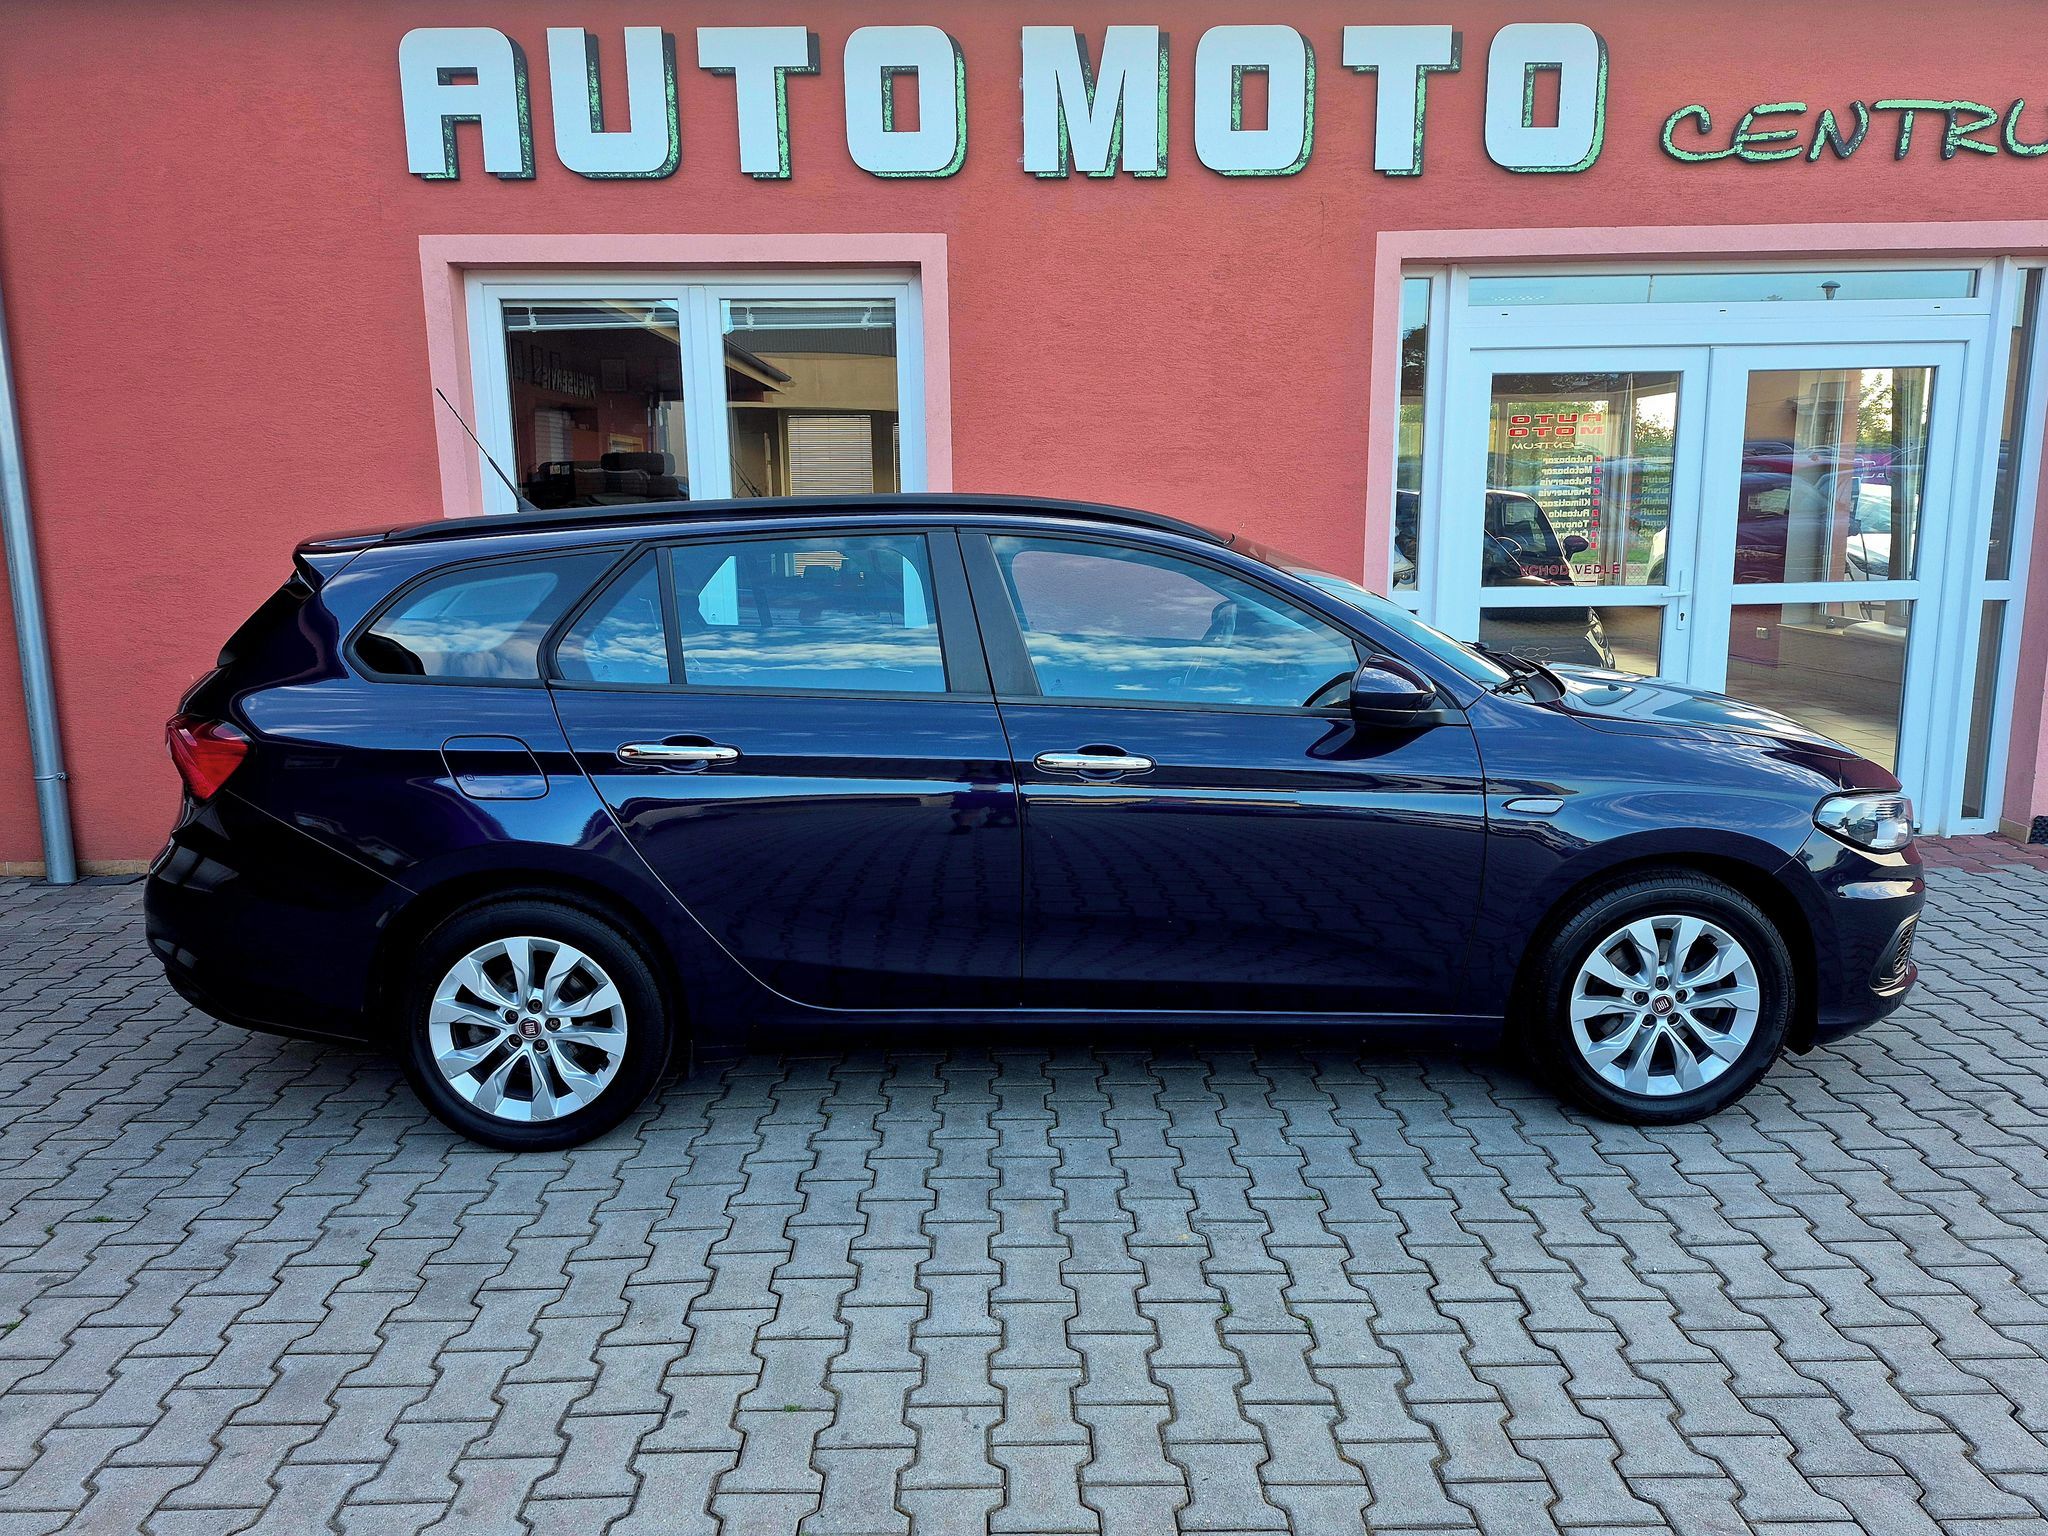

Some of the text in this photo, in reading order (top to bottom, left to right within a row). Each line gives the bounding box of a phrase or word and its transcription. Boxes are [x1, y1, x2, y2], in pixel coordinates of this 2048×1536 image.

[398, 26, 967, 180] AUTO
[1022, 23, 1608, 178] MOTO
[1574, 564, 1621, 575] VEDLE
